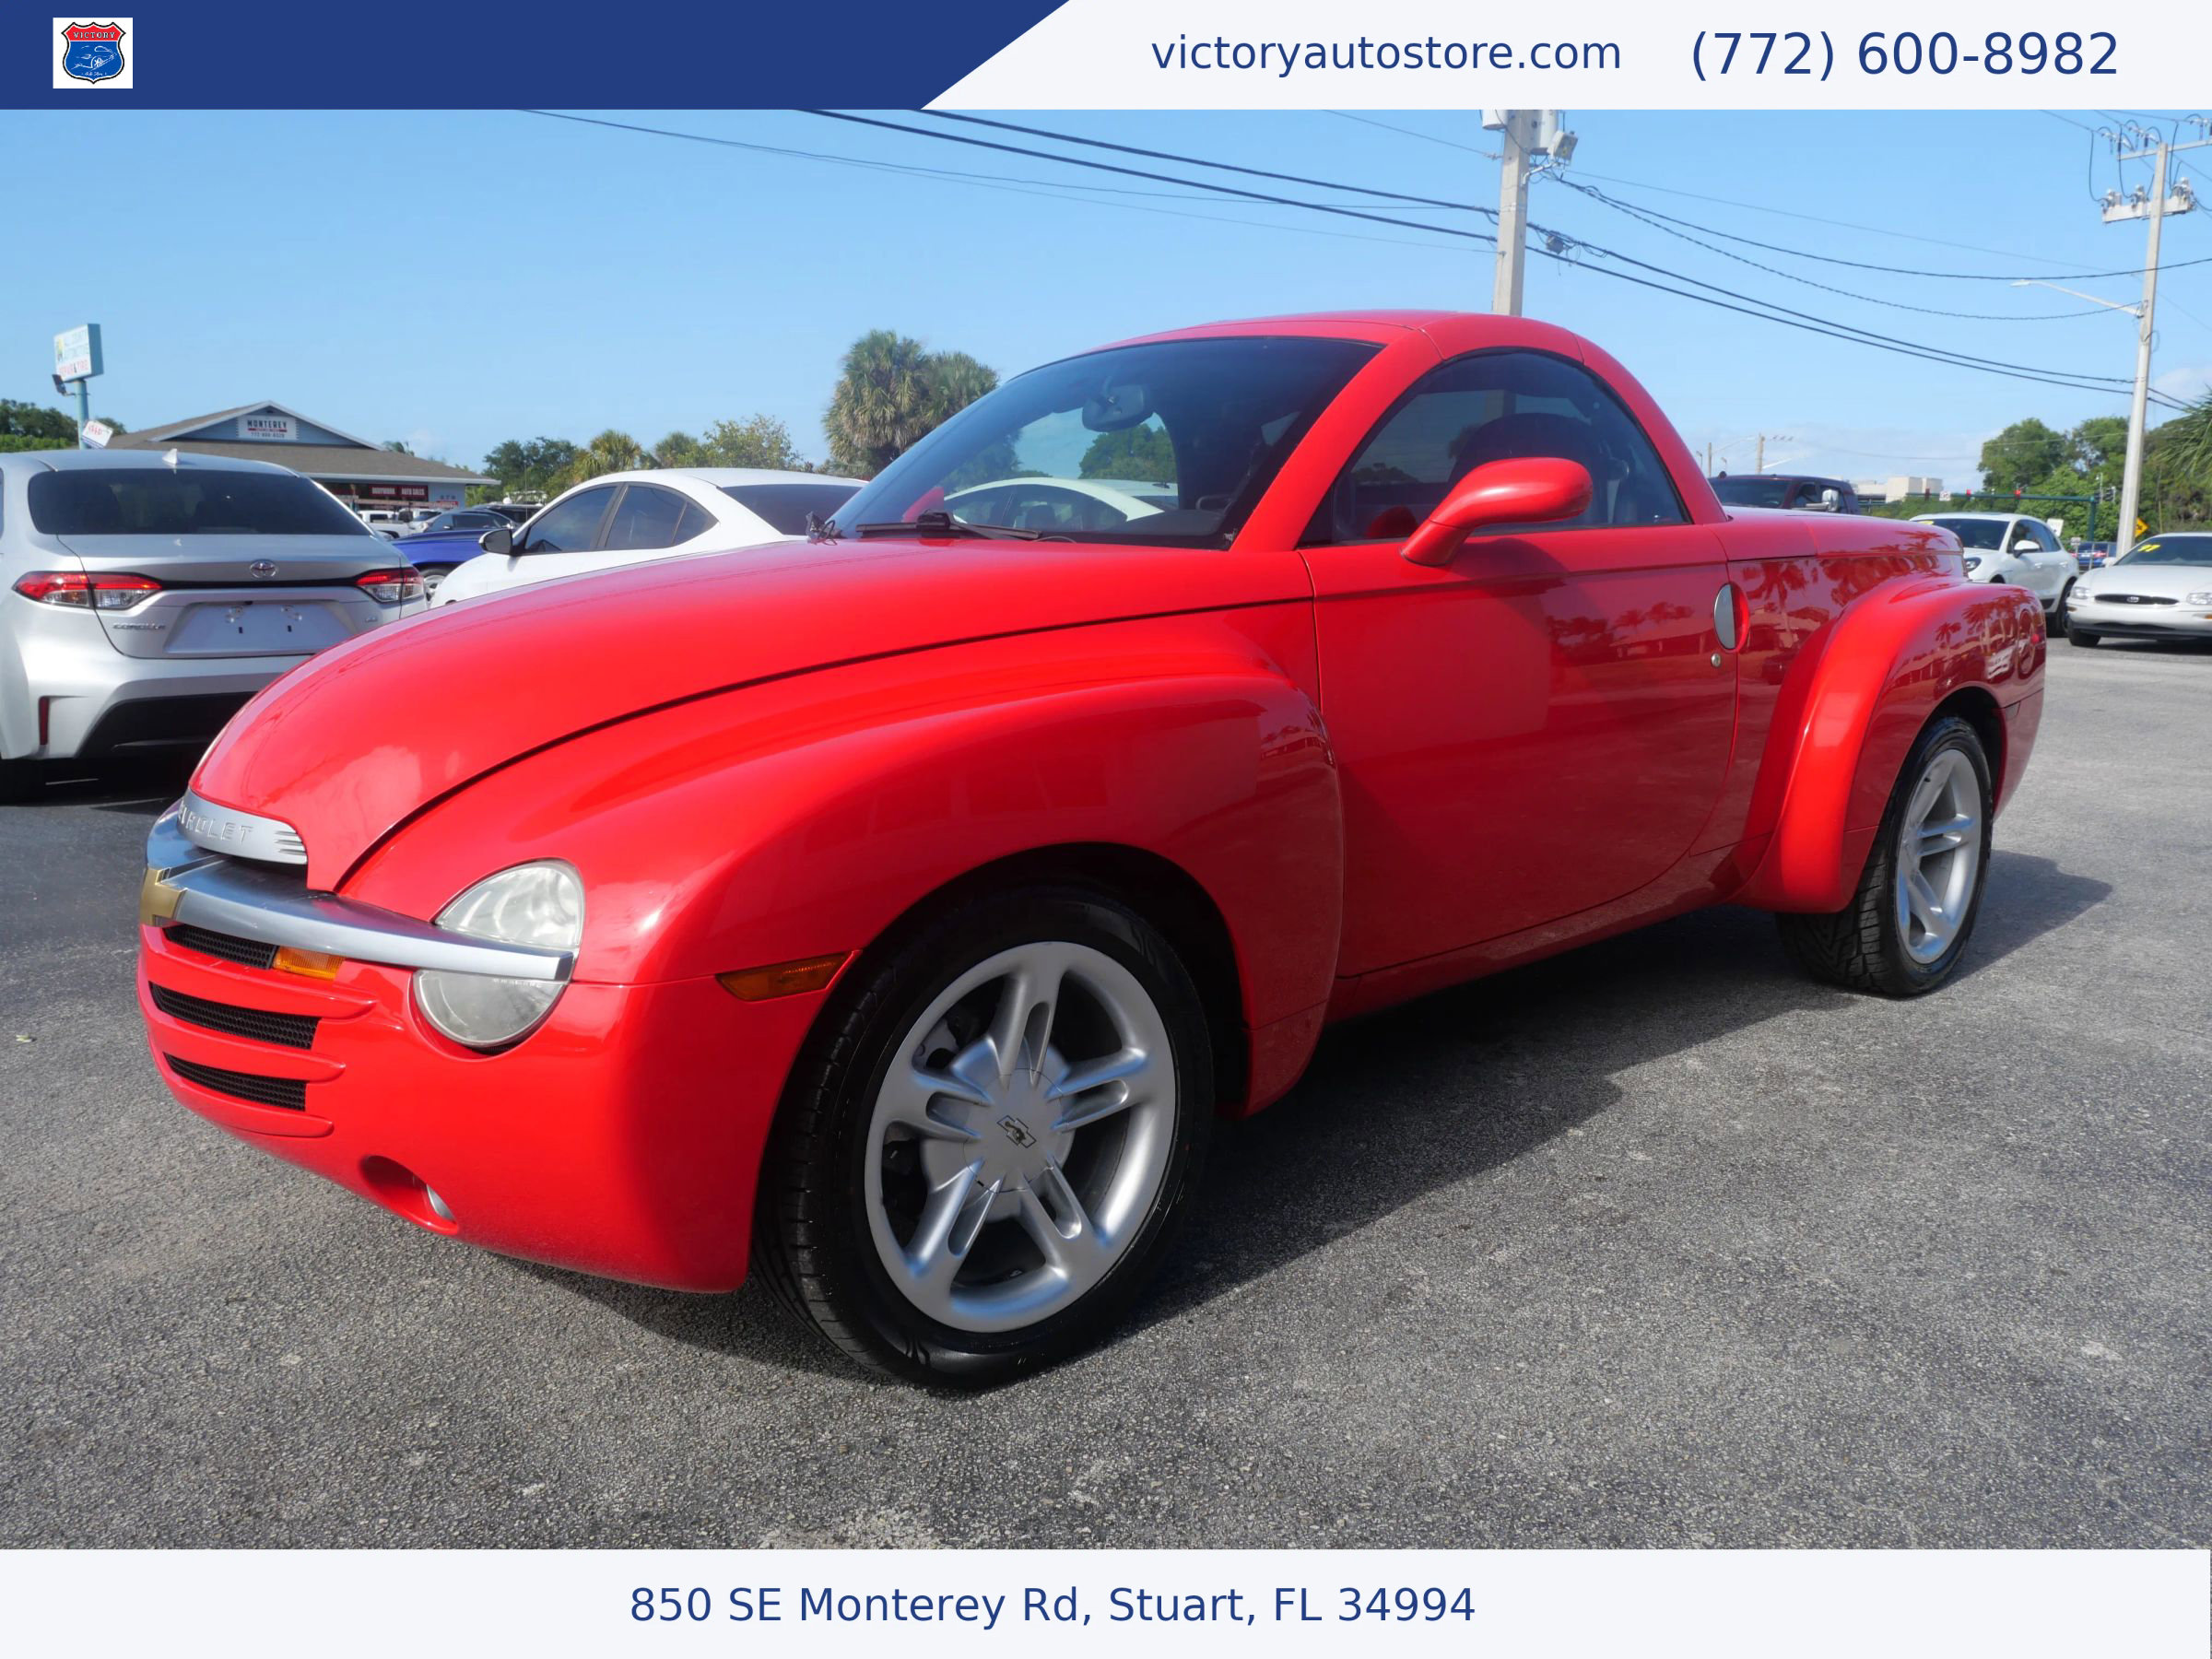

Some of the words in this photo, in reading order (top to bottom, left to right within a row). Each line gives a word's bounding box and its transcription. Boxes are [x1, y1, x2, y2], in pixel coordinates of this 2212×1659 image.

[247, 419, 288, 429] MONTEREY
[401, 488, 412, 496] AUTO
[412, 488, 425, 496] SALES
[112, 621, 166, 630] COROLLA
